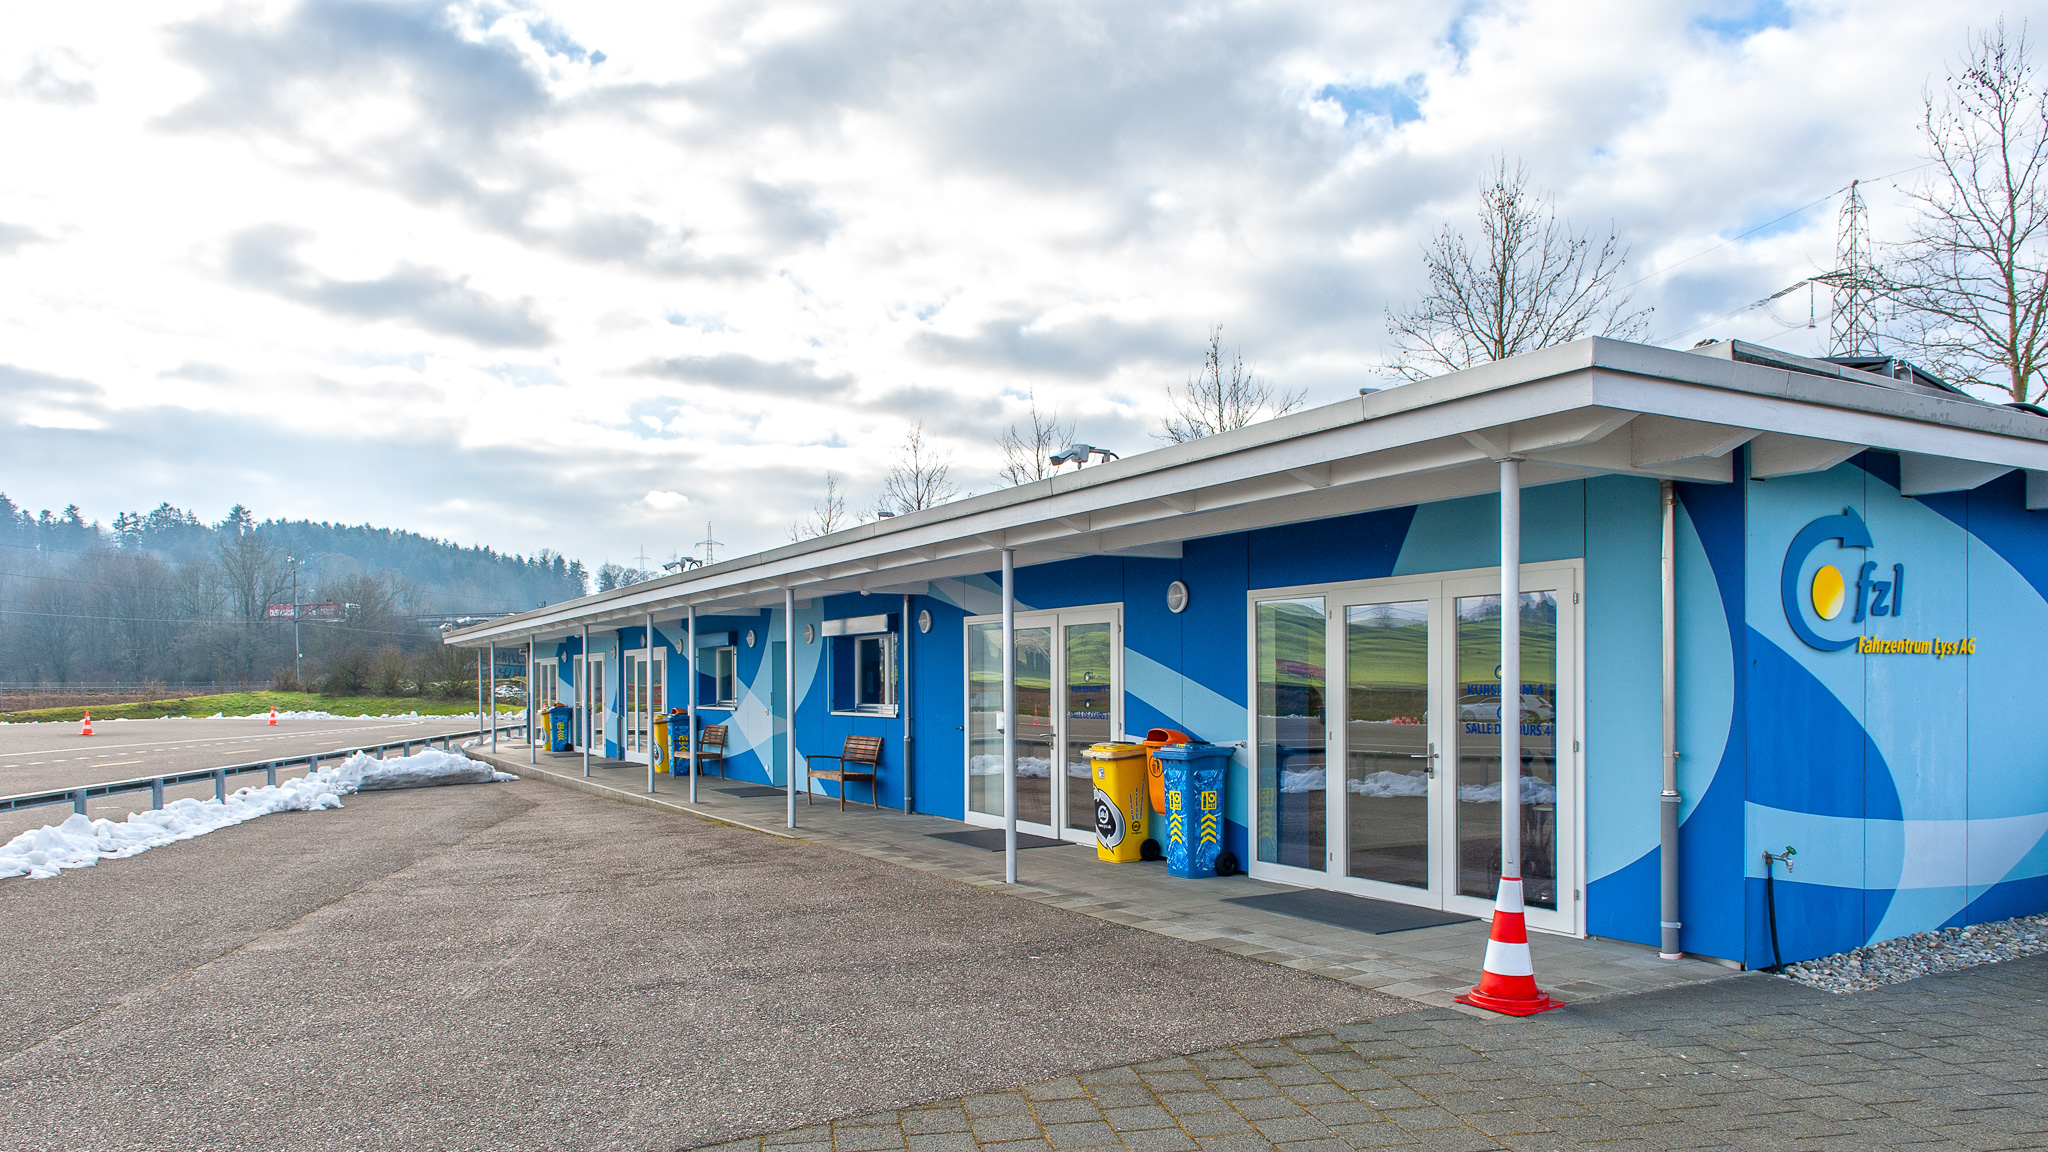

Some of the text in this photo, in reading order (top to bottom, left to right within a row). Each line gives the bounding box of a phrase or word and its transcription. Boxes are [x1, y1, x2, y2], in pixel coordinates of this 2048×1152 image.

[1854, 560, 1905, 623] fzl
[1857, 634, 1976, 659] Fahrzentrum Lyss AG
[1467, 684, 1544, 695] KURSRM 4
[1466, 723, 1491, 734] SALLE
[1544, 725, 1551, 736] 4
